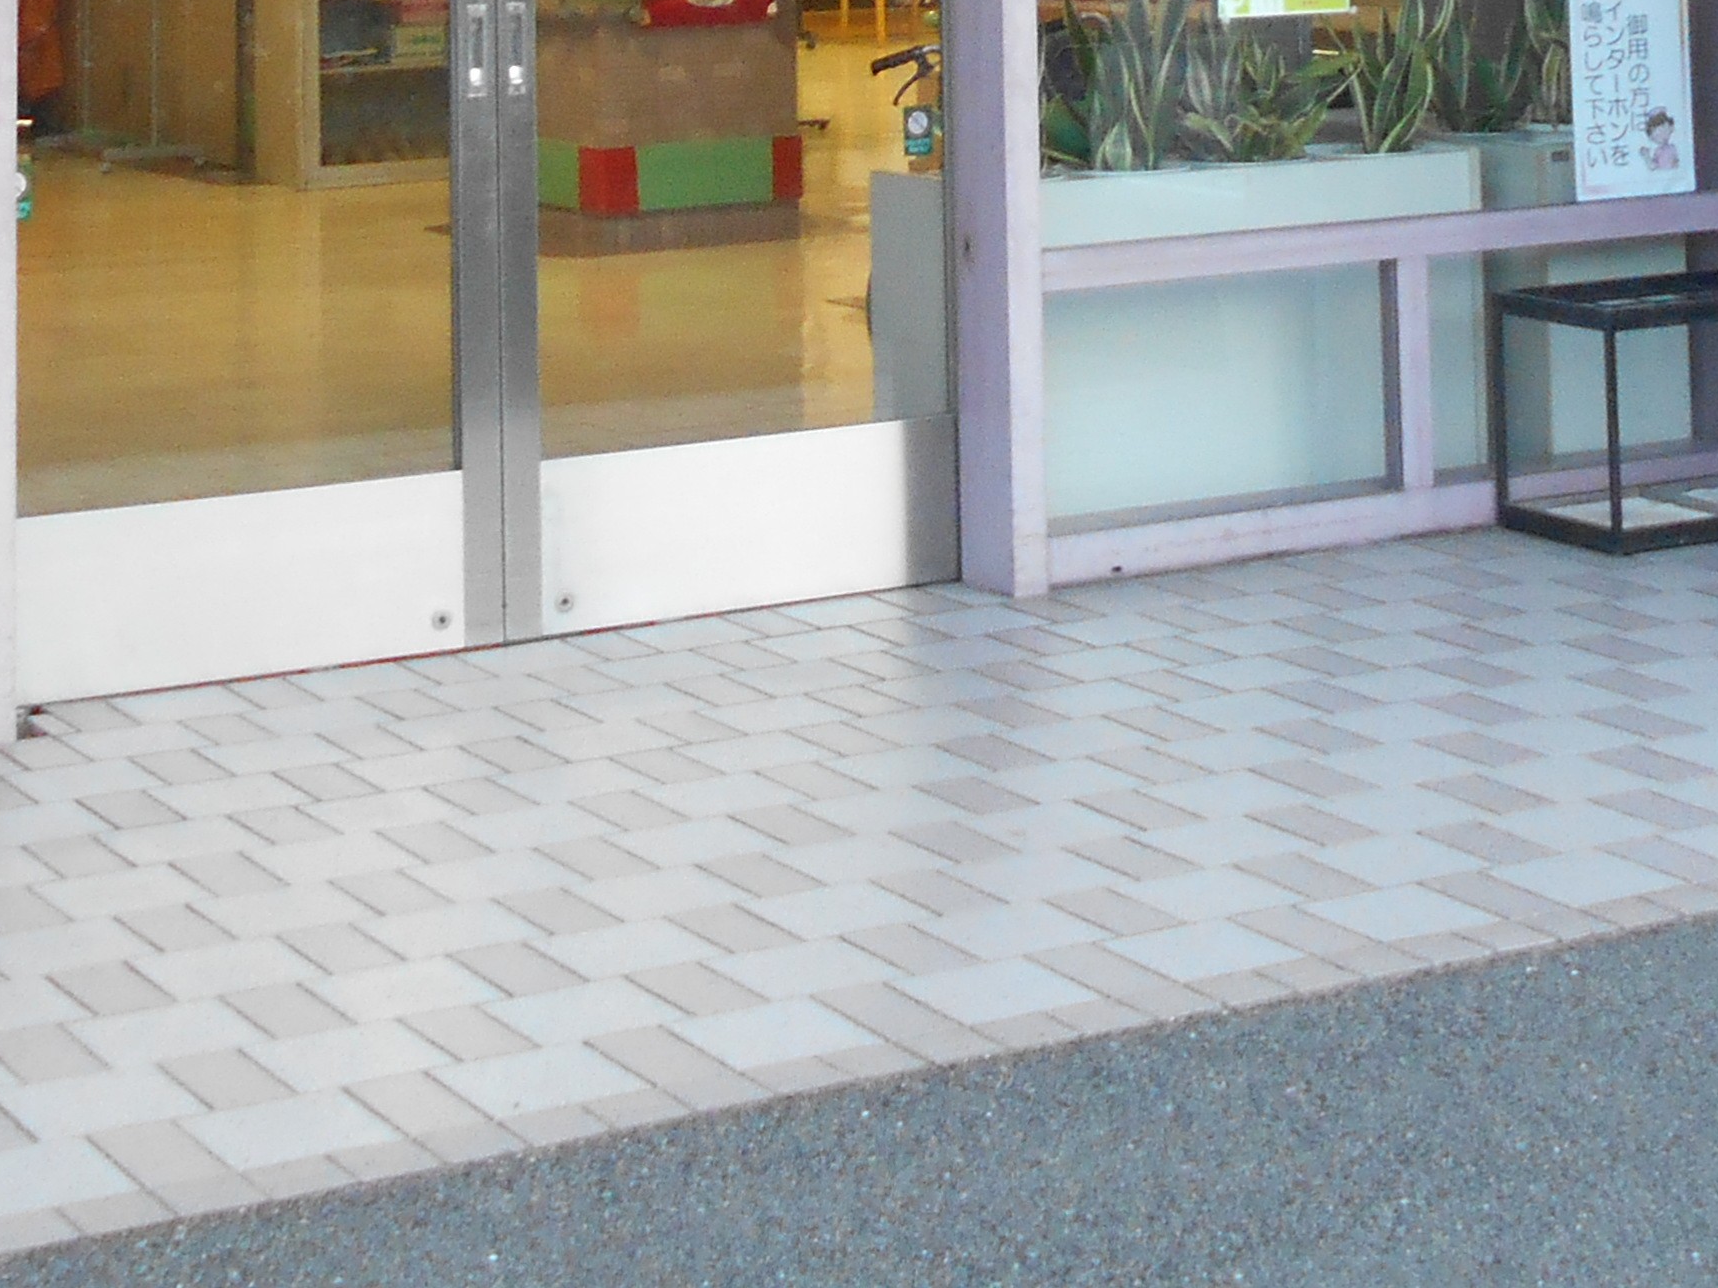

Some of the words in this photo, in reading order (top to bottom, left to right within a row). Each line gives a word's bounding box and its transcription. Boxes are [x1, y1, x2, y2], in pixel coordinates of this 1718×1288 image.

[1582, 1, 1607, 168] 鳴らして下さい
[1606, 0, 1630, 167] インターホンを
